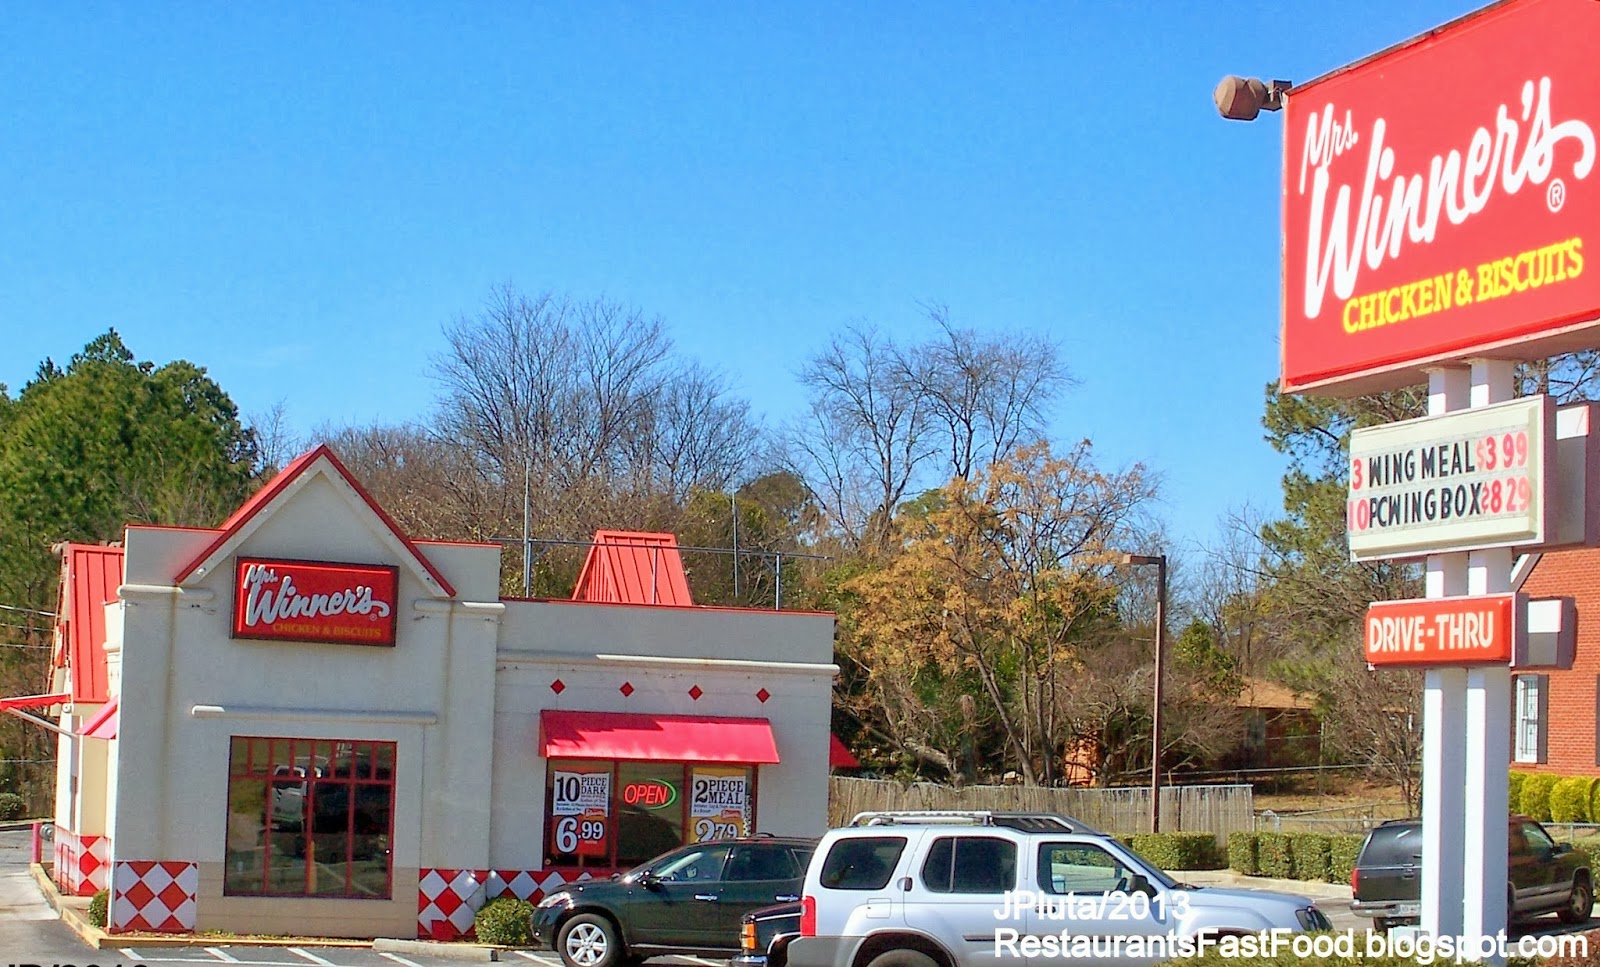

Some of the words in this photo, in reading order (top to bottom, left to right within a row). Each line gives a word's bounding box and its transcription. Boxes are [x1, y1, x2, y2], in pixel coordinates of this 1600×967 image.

[1300, 103, 1358, 194] Mrs.
[1304, 76, 1596, 319] Winner's
[1343, 273, 1453, 333] CHICKEN
[1455, 268, 1474, 306] &
[1476, 237, 1584, 302] BISCUITS
[1352, 459, 1363, 490] 3
[1369, 450, 1415, 488] WING
[1421, 441, 1475, 480] MEAL
[243, 564, 278, 589] Mrs.
[245, 575, 390, 626] Winner's
[272, 623, 319, 633] CHICKEN
[322, 627, 331, 635] &
[333, 627, 382, 637] BISCUITS
[1369, 611, 1494, 653] DRIVE-THRU
[556, 776, 580, 802] 10
[581, 777, 607, 787] PIECE
[581, 786, 606, 795] DARK
[624, 784, 668, 805] OPEN
[695, 780, 708, 803] 2
[709, 780, 744, 793] PIECE
[708, 791, 743, 805] MEAL
